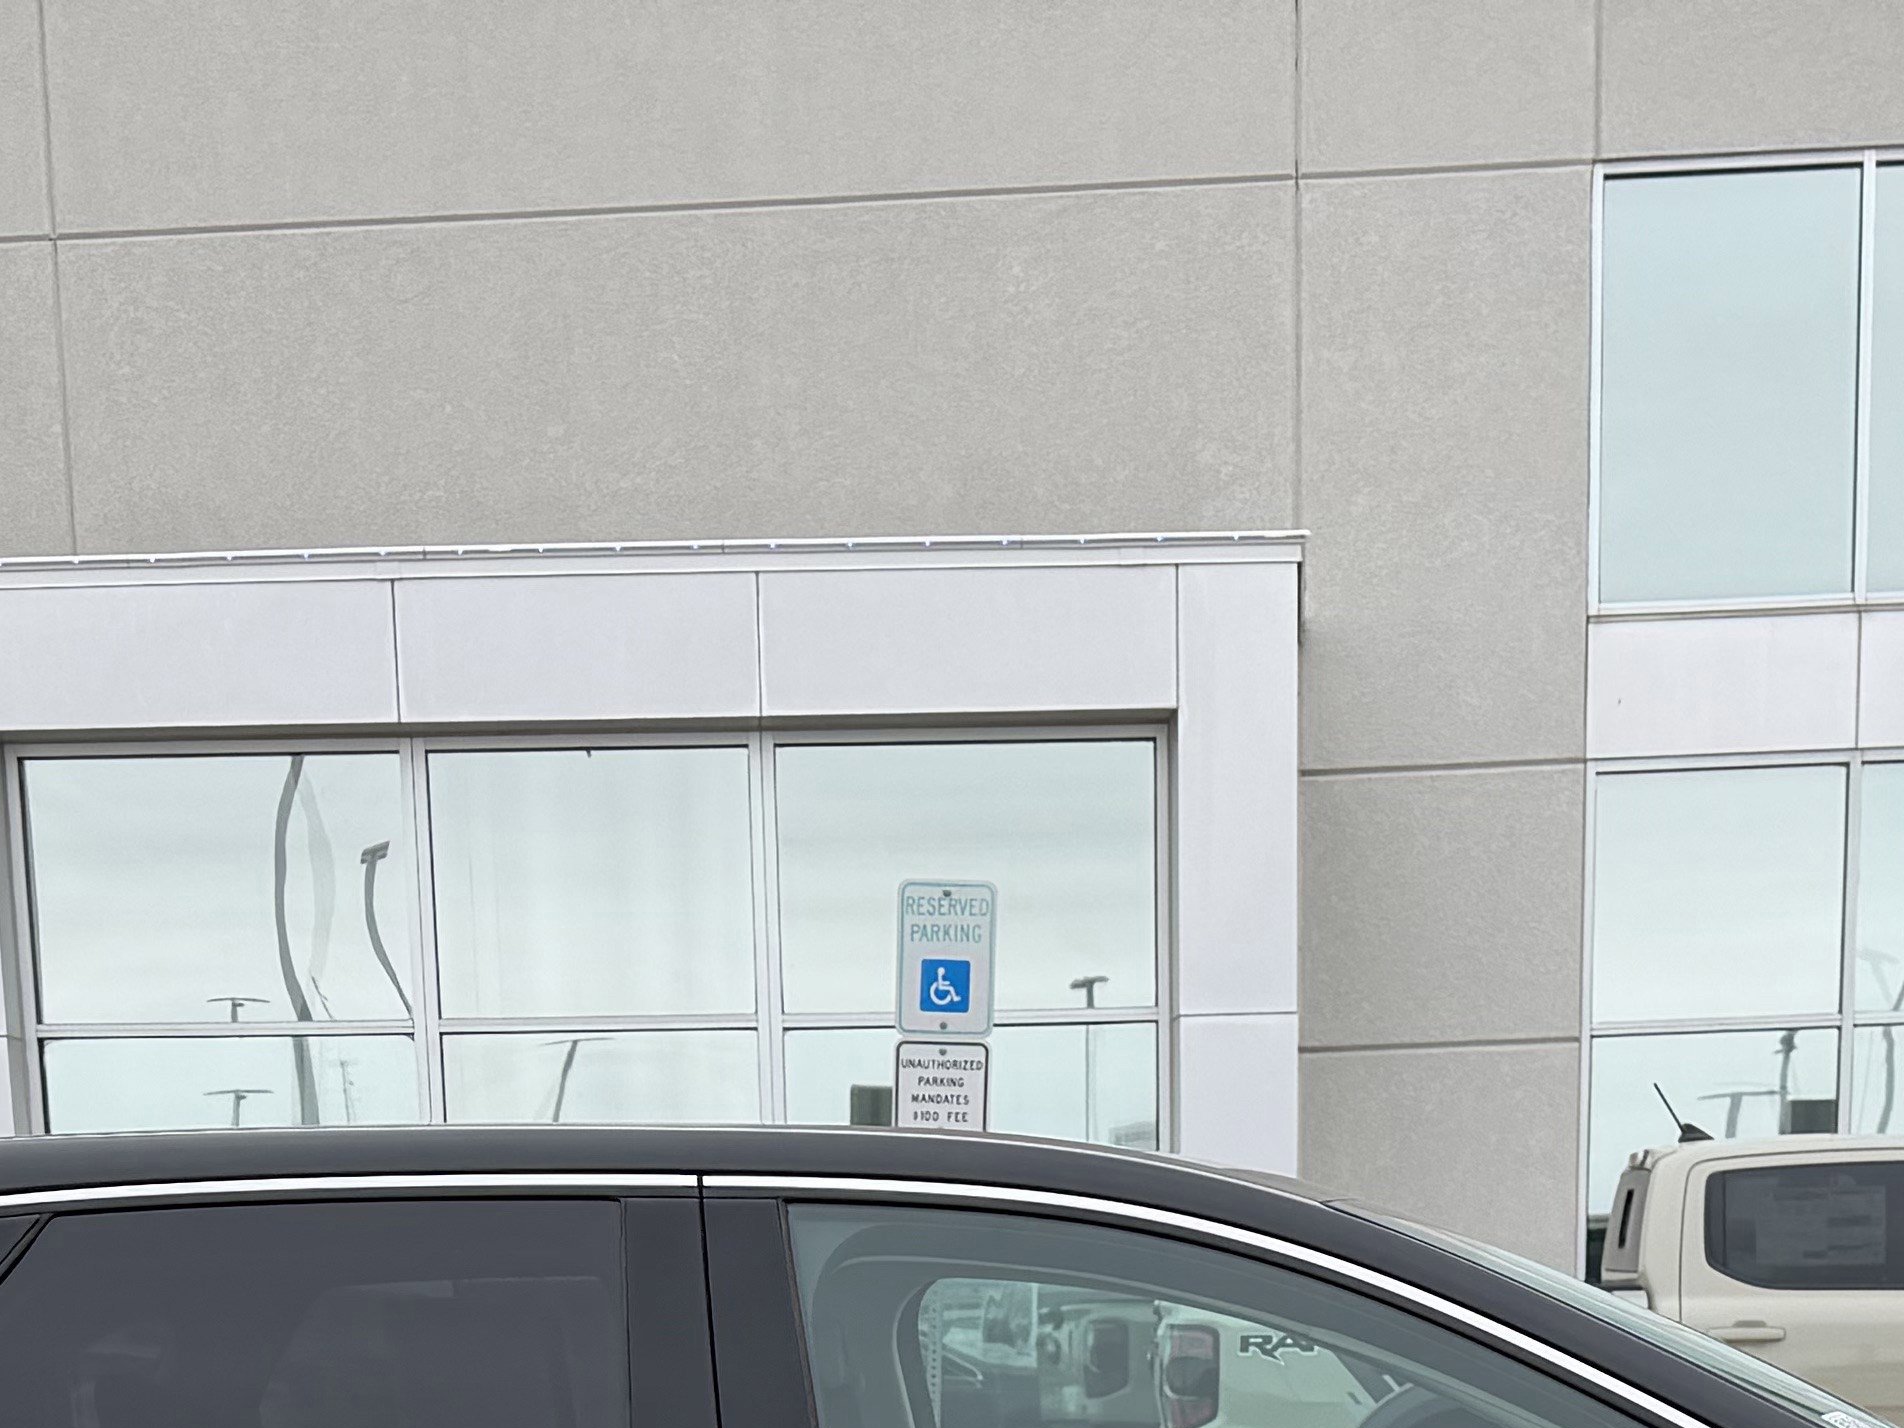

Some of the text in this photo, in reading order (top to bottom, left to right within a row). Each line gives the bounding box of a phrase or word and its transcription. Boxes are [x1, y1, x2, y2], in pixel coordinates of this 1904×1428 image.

[904, 895, 989, 917] RESERVED
[910, 924, 982, 943] PARKING
[900, 1058, 984, 1071] UNAUTHORIZED
[917, 1076, 965, 1088] PARKING
[911, 1093, 970, 1106] MANDATES
[946, 1111, 969, 1123] FEE
